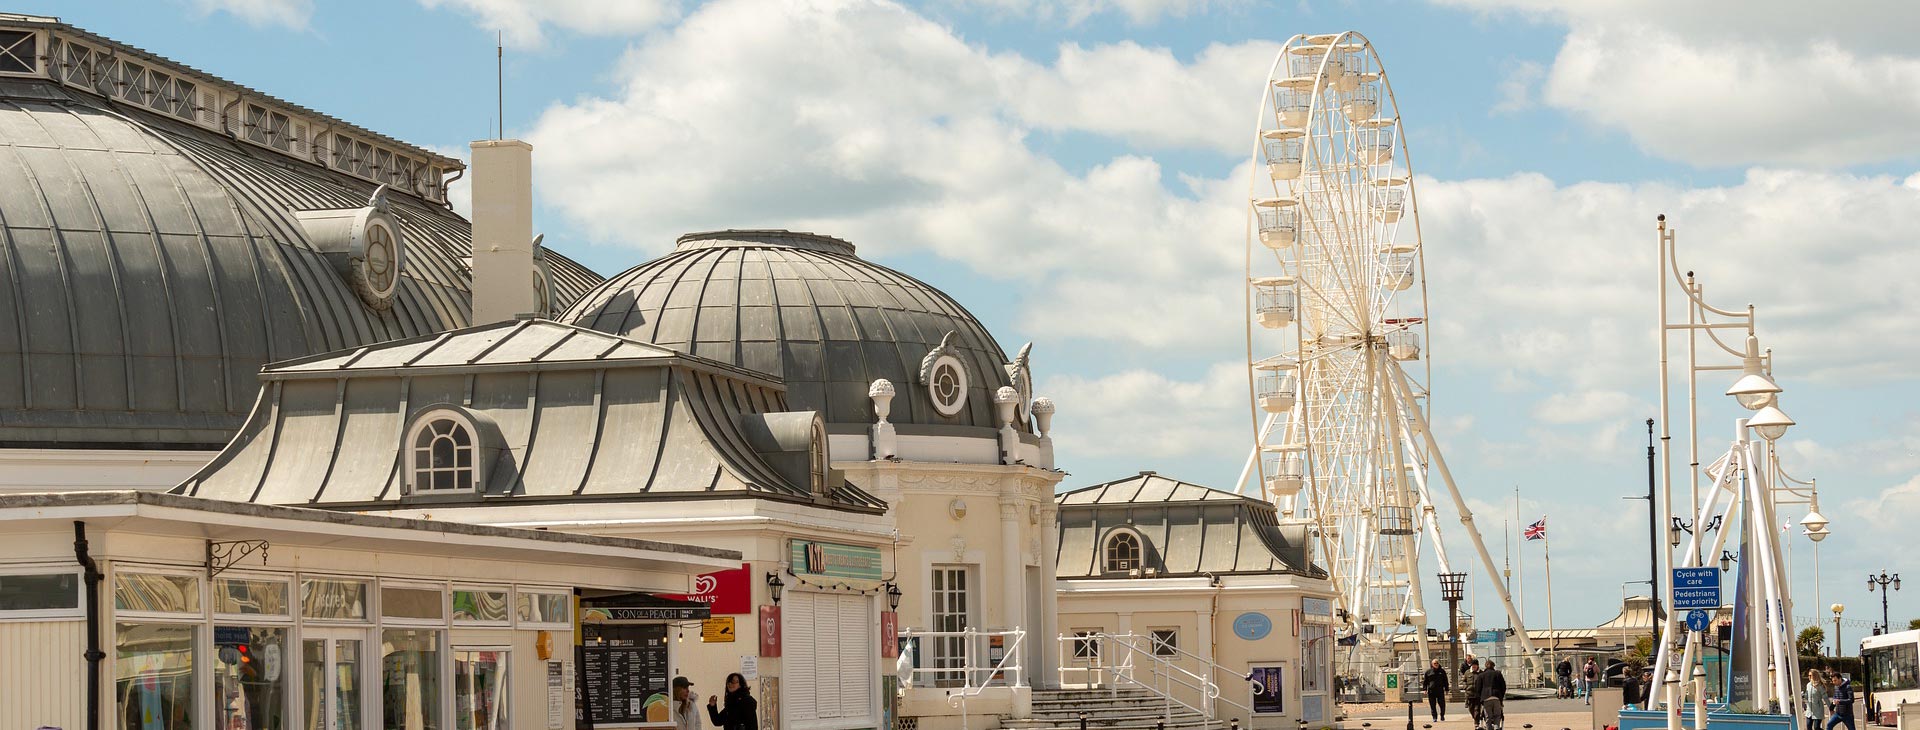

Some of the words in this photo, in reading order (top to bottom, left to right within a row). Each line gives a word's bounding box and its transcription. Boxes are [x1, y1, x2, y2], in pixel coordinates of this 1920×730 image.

[1676, 571, 1696, 579] Cycle
[1675, 590, 1716, 598] Pedestrians
[1692, 598, 1718, 606] priority
[617, 609, 635, 619] SON
[649, 609, 677, 619] PEACH
